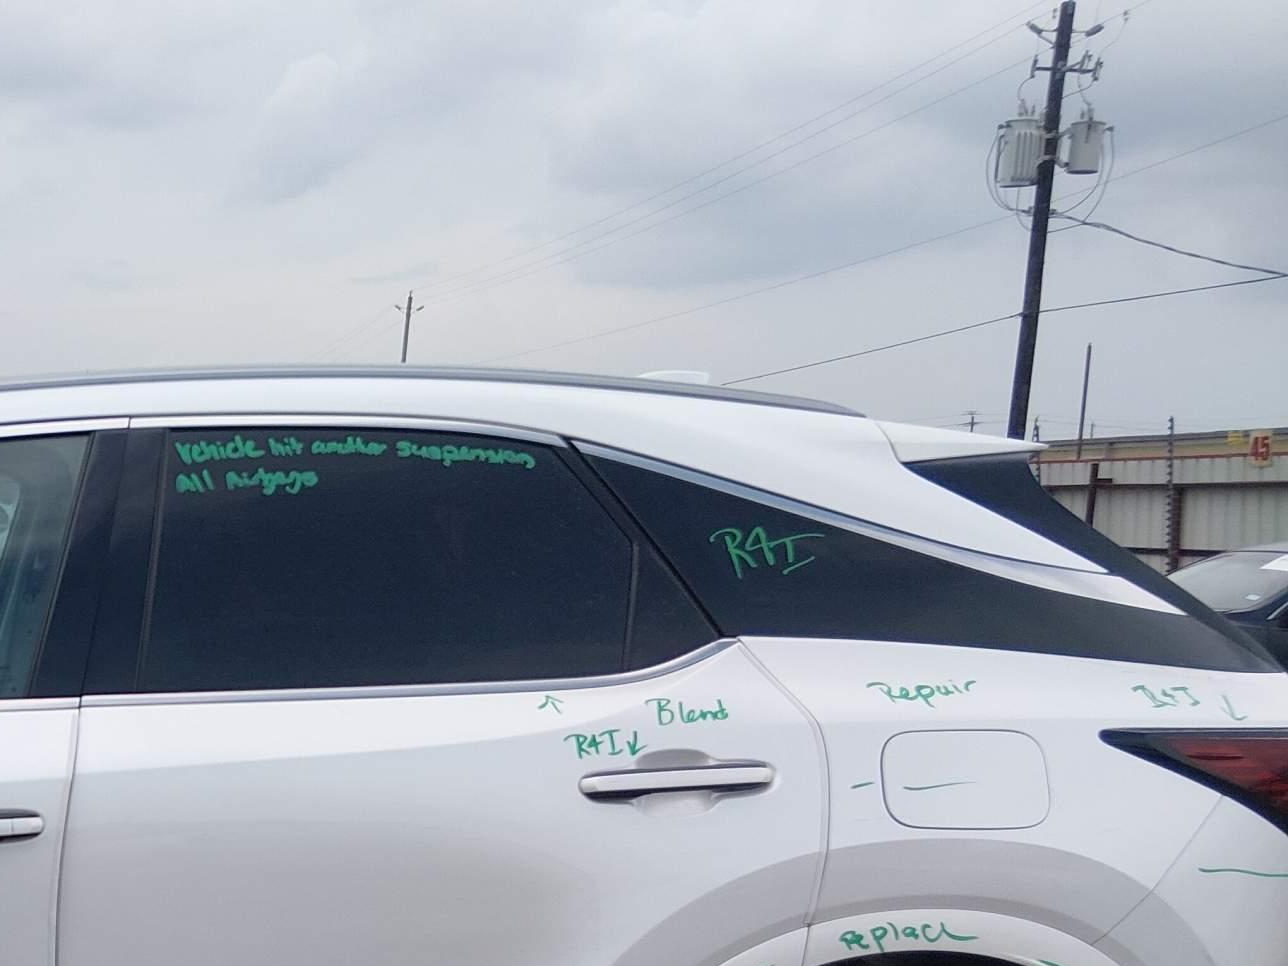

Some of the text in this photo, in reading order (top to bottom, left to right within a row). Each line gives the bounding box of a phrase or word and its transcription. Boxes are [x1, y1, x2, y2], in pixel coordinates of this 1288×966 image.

[175, 468, 215, 494] All
[866, 680, 977, 708] Repair
[645, 697, 729, 726] Blend
